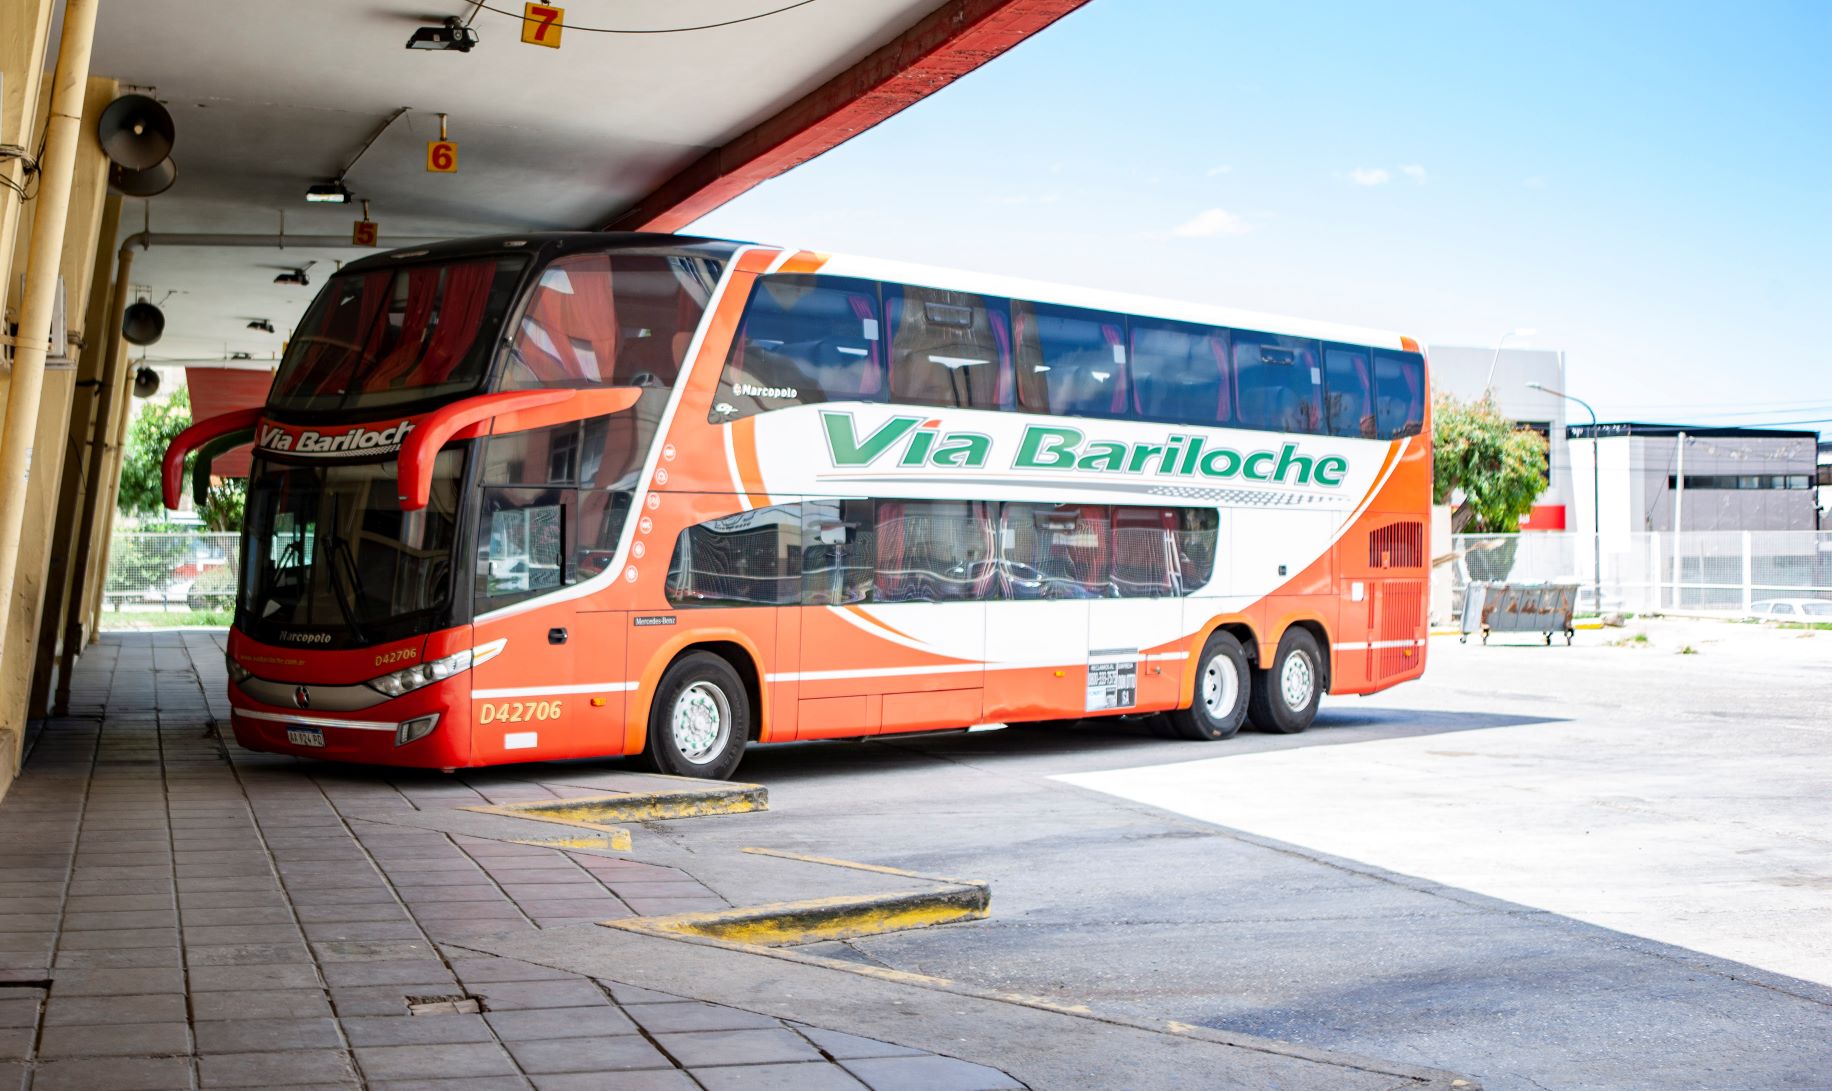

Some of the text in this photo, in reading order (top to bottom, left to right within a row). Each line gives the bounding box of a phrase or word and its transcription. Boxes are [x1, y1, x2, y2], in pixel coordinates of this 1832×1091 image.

[531, 6, 559, 41] 7
[432, 143, 453, 170] 6
[357, 223, 374, 244] 5
[295, 420, 416, 452] Bariloch
[1010, 423, 1351, 488] Bariloche
[374, 648, 417, 667] D42706
[480, 701, 562, 725] D42706
